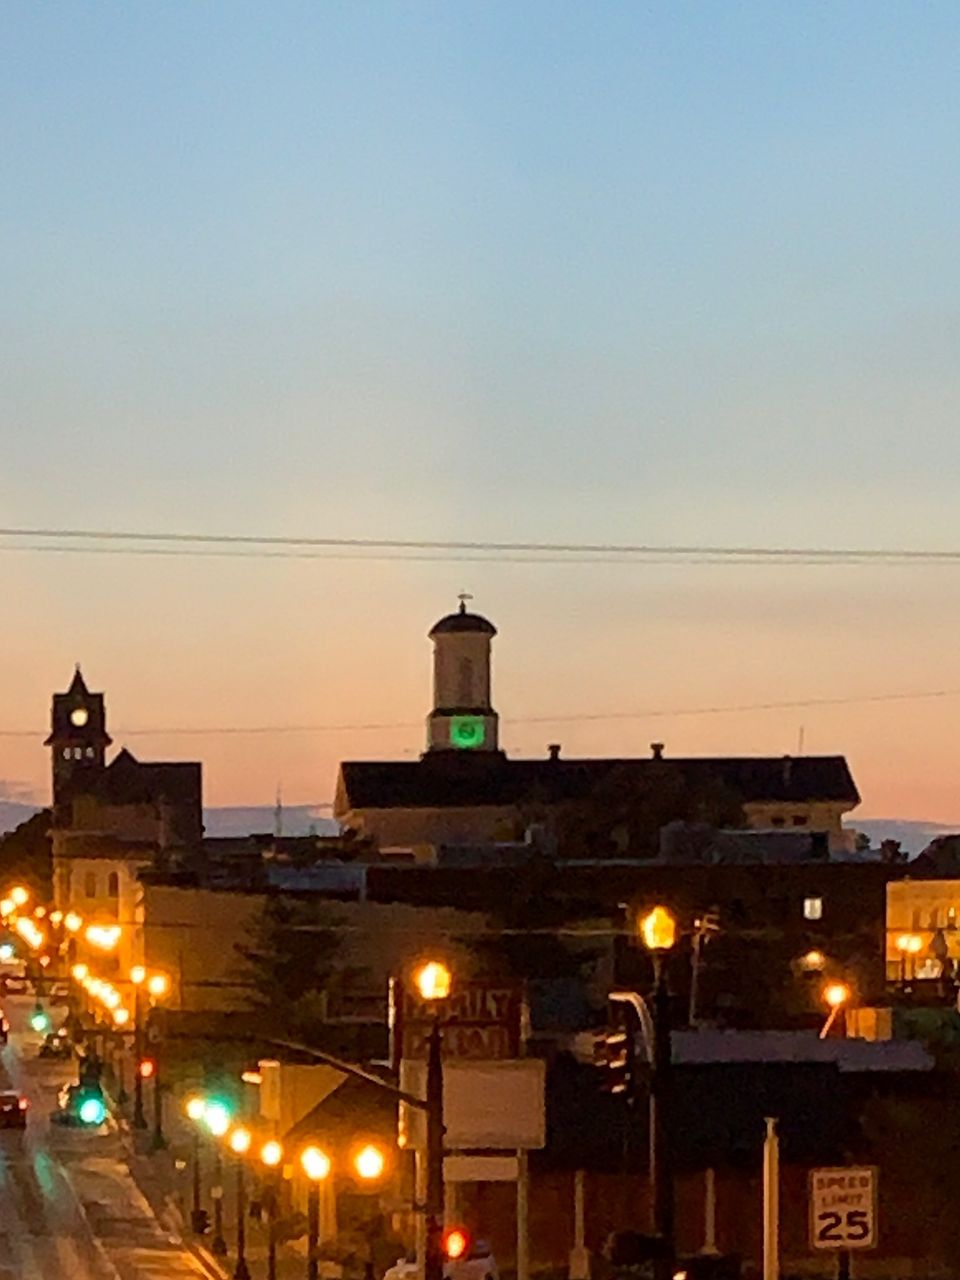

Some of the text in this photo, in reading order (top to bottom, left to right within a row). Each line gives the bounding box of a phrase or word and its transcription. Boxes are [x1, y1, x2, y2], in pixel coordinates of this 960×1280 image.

[816, 1176, 869, 1191] SPEED
[821, 1193, 863, 1207] LIMIT
[818, 1211, 869, 1241] 25
